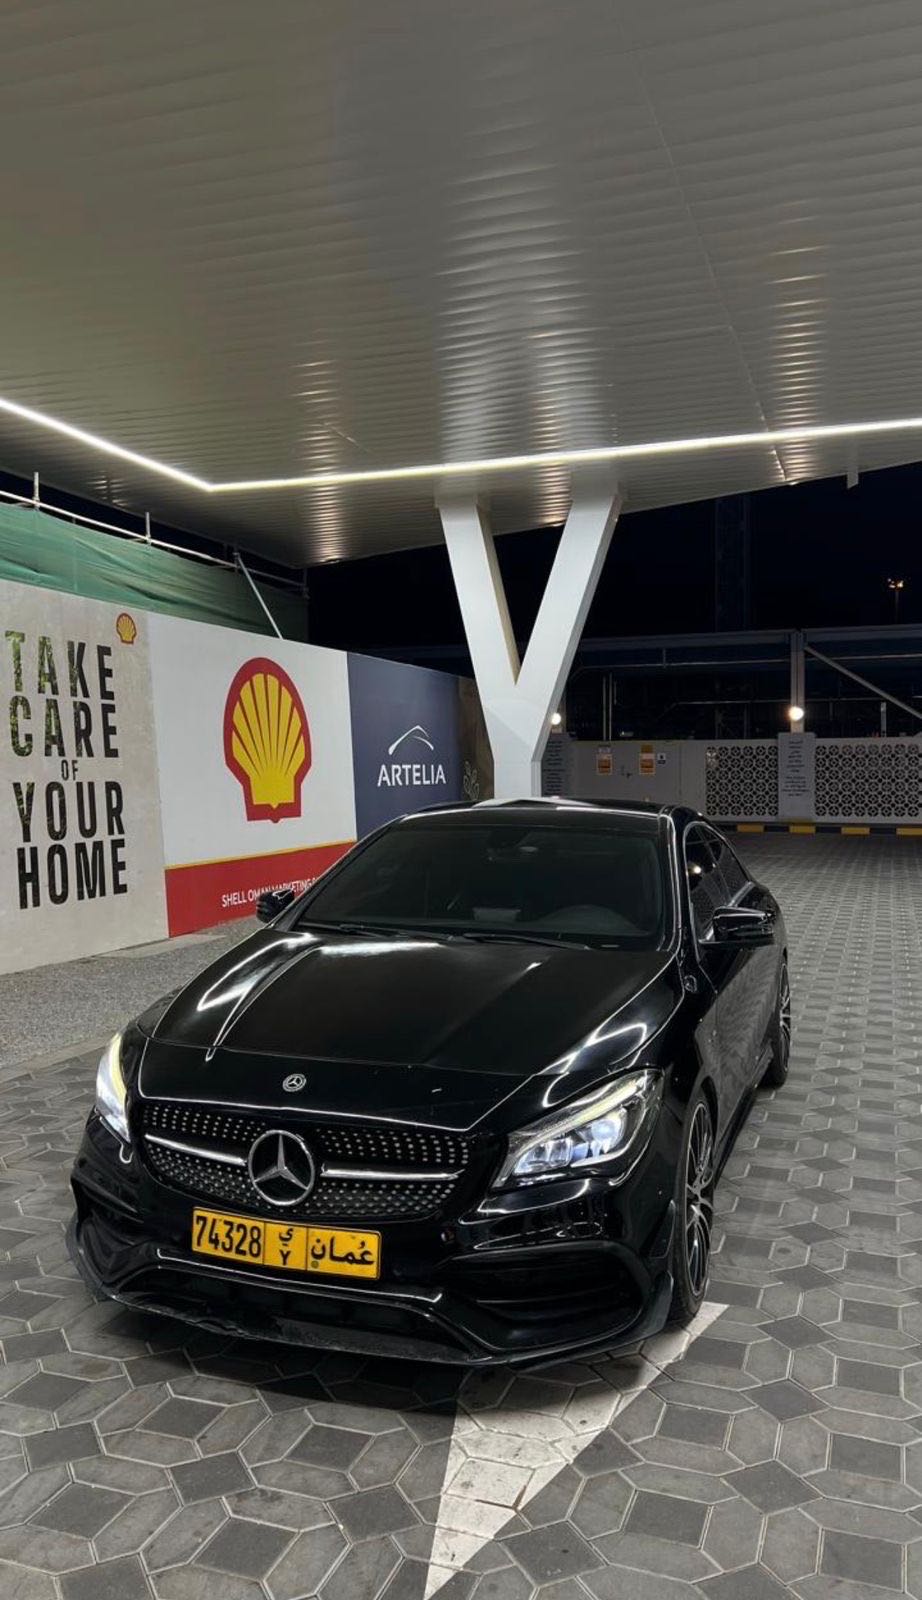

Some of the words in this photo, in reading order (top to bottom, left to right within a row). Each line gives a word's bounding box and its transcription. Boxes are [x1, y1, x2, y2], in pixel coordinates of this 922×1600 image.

[5, 630, 115, 701] TAKE
[9, 695, 119, 758] CARE
[61, 759, 78, 781] OF
[377, 764, 447, 788] ARTELIA
[12, 781, 125, 843] YOUR
[17, 839, 128, 910] HOME
[221, 891, 247, 908] SHELL
[195, 1215, 261, 1258] 74328
[279, 1249, 291, 1266] Y
